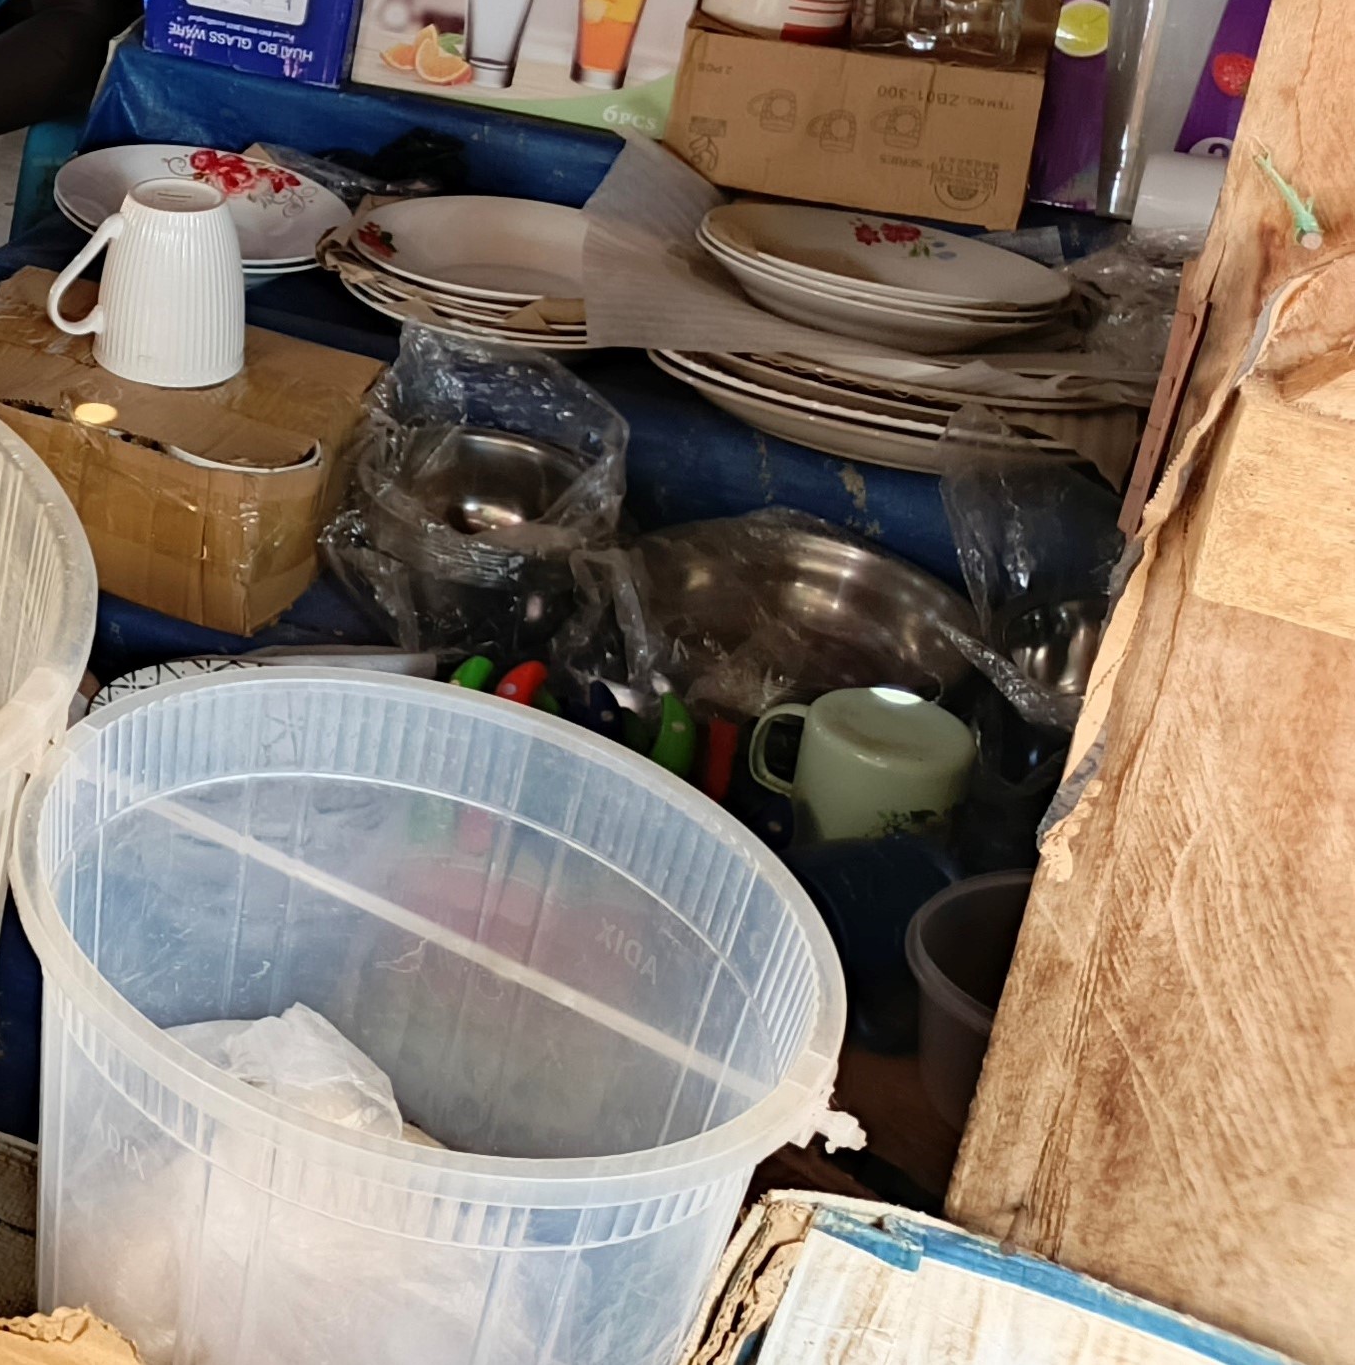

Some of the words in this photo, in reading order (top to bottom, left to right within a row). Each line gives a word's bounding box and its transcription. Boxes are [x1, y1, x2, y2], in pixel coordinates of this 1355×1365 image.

[168, 21, 206, 41] WARE
[209, 31, 252, 50] GLASS
[258, 41, 277, 55] BO
